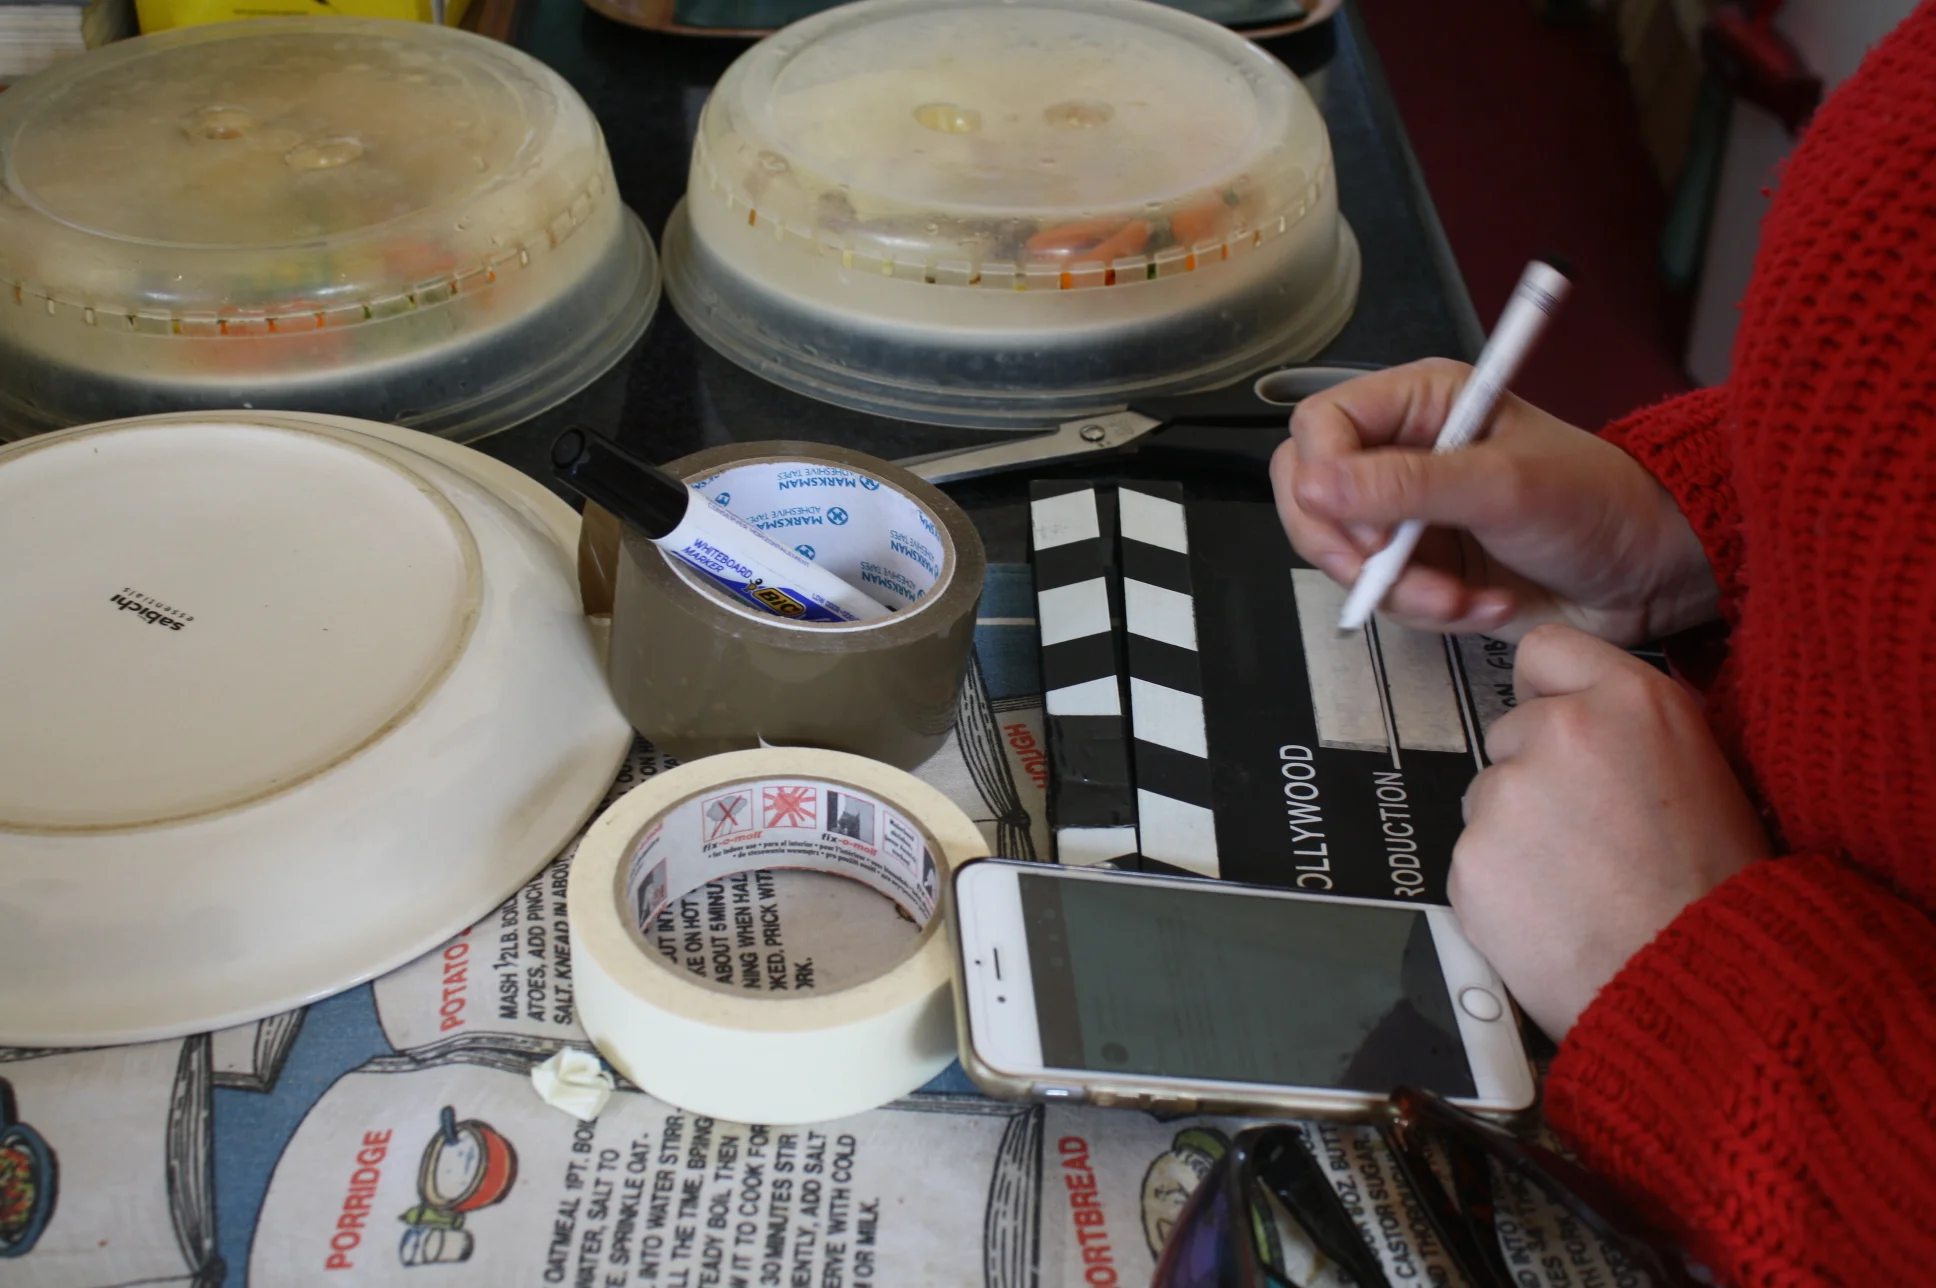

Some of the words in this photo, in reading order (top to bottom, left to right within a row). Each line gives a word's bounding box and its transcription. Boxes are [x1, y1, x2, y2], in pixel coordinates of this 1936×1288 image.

[779, 477, 856, 490] MARKSMAN
[746, 513, 768, 523] TAPE
[682, 546, 725, 572] MARKER
[693, 538, 753, 580] WHITEBOARD
[890, 540, 934, 576] MARKSMAN
[122, 587, 194, 621] essentials
[861, 571, 916, 602] MARKSMAN
[110, 594, 184, 631] sabichi
[552, 902, 568, 917] IN
[681, 899, 699, 929] HOT
[734, 906, 755, 948] WHEN
[760, 903, 783, 947] PRICK
[527, 925, 546, 958] ADD
[553, 921, 572, 979] KNEAD
[684, 932, 702, 952] ON
[711, 936, 734, 985] ABOUT
[440, 943, 473, 1032] POTATO
[499, 973, 519, 1019] MASH
[527, 963, 549, 1022] ATOES,
[553, 980, 573, 1026] SALT.
[597, 1149, 620, 1172] TO
[714, 1135, 740, 1182] THEN
[774, 1133, 799, 1173] STIR
[804, 1130, 828, 1175] SALT
[831, 1134, 857, 1184] COLD
[324, 1128, 393, 1271] PORRIDGE
[588, 1178, 613, 1220] SALT
[646, 1169, 676, 1230] WATER
[738, 1163, 765, 1217] COOK
[800, 1179, 822, 1218] ADD
[609, 1178, 645, 1265] SPRINKLE
[764, 1179, 793, 1259] MINUTES
[826, 1187, 850, 1236] WITH
[856, 1197, 880, 1246] MILK.
[1058, 1136, 1118, 1288] ORTBREAD
[544, 1197, 581, 1283] OATMEAL
[671, 1225, 696, 1261] THE
[735, 1221, 758, 1246] TO
[1374, 1205, 1417, 1280] CASTOR
[638, 1235, 663, 1279] INTO
[732, 1253, 753, 1271] IT
[760, 1260, 782, 1287] 30
[853, 1250, 875, 1279] OR
